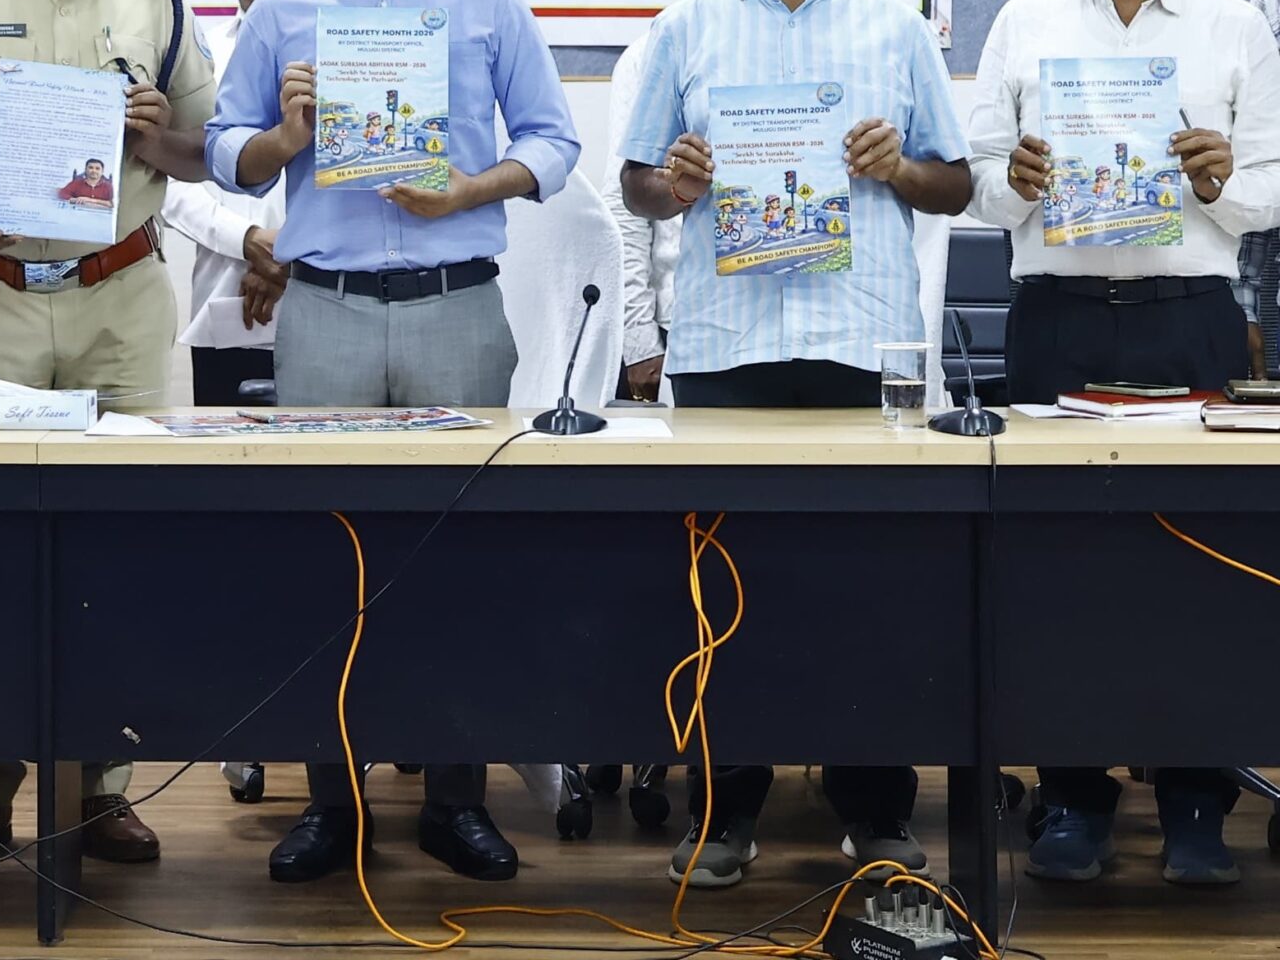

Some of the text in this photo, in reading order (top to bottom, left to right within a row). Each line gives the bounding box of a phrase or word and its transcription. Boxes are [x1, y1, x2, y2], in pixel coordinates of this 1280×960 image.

[1084, 224, 1103, 232] ROAD
[775, 249, 797, 257] SAFETY
[5, 406, 33, 422] Soft
[36, 406, 70, 417] Tissue
[863, 939, 900, 956] PLATINUM
